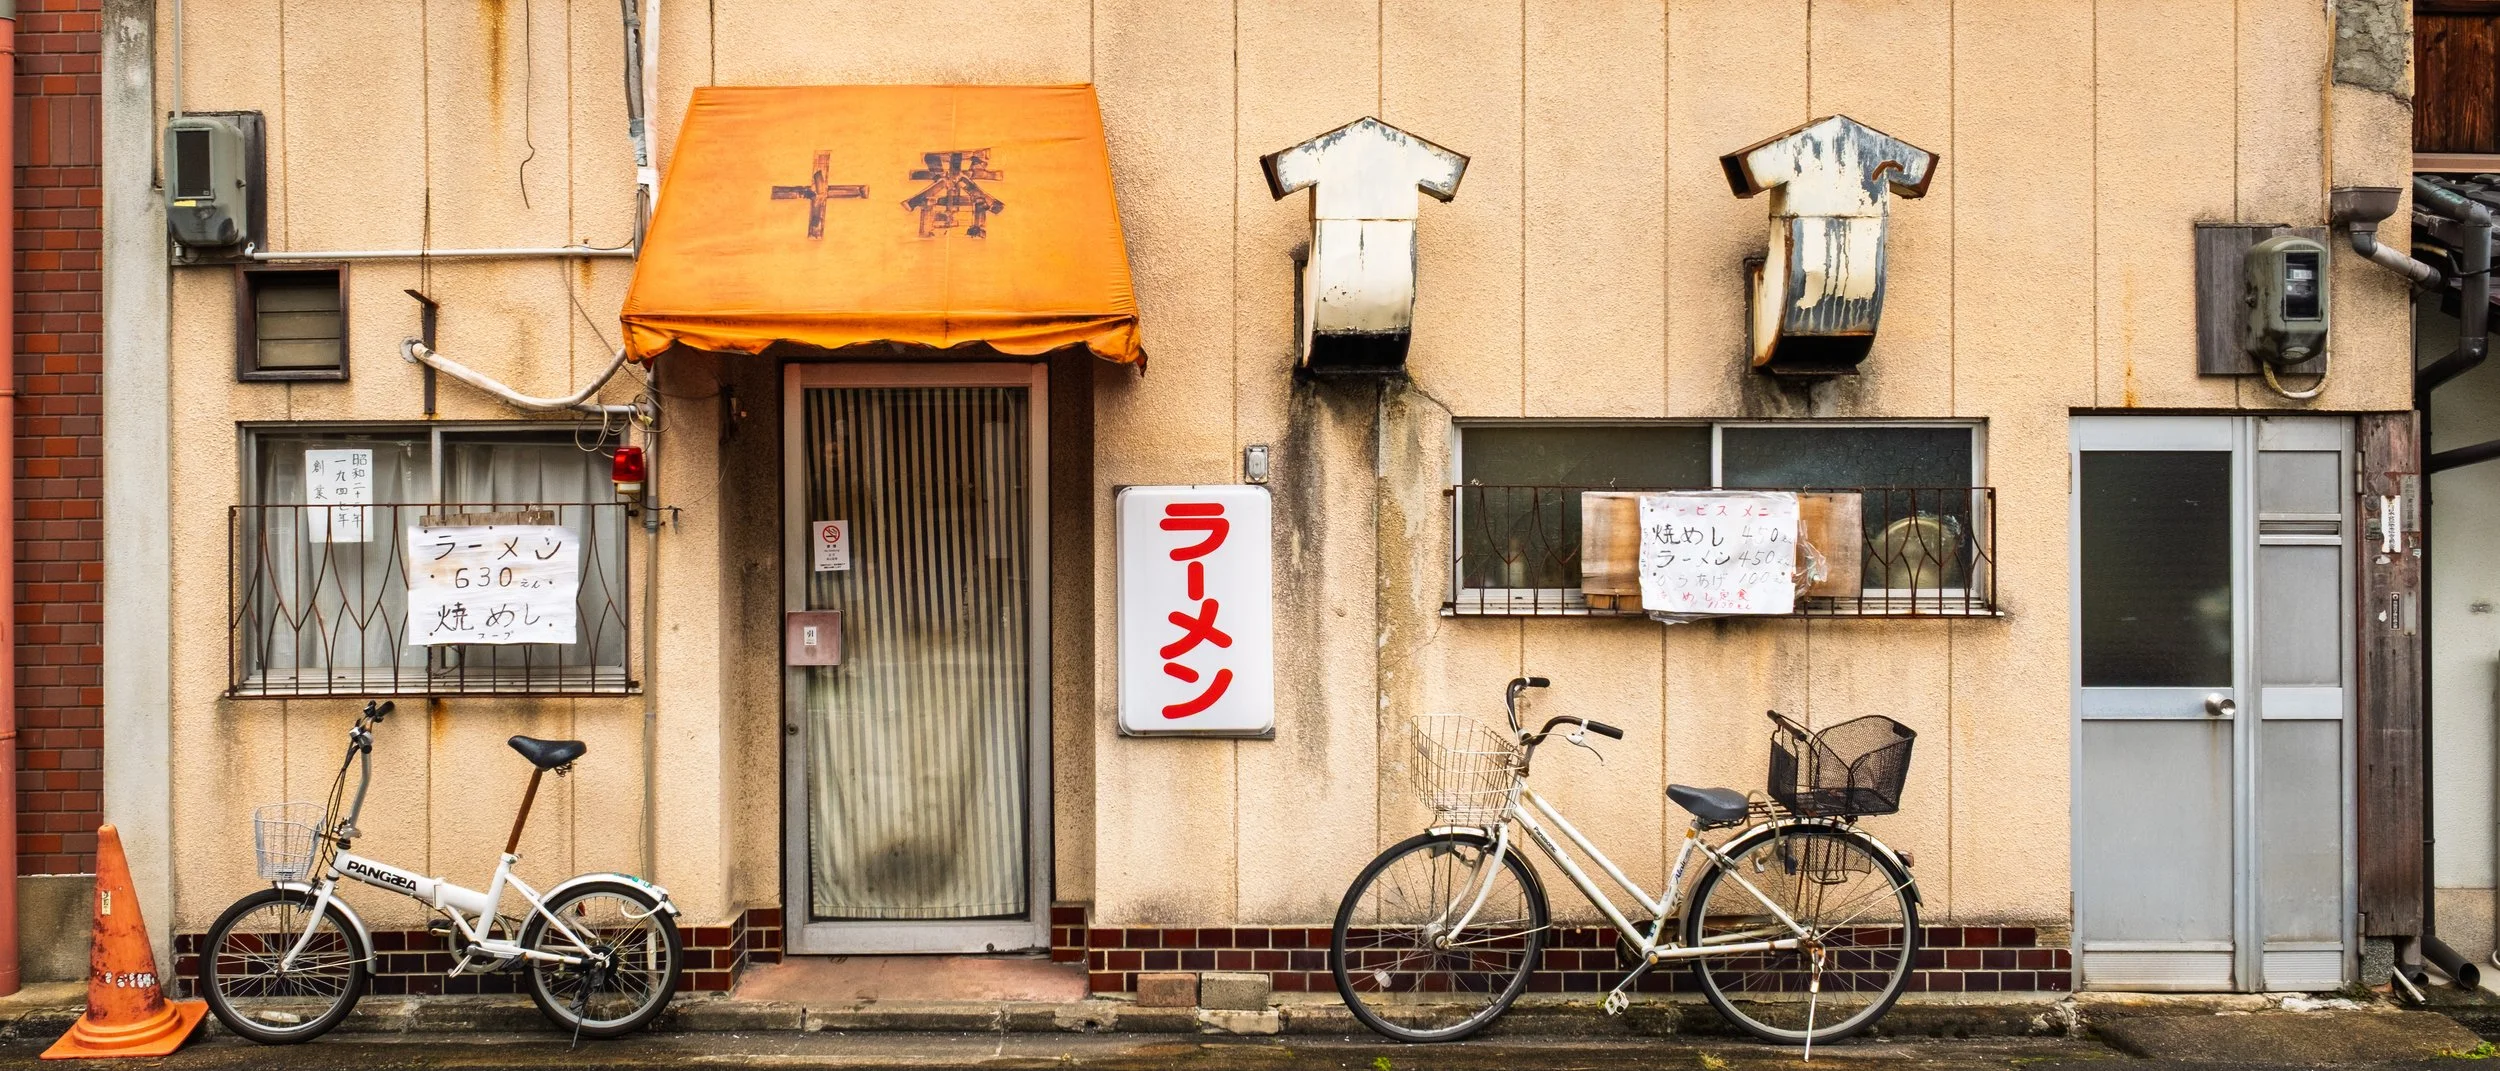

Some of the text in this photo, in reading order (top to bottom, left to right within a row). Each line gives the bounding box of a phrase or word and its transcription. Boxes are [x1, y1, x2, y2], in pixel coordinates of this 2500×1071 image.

[770, 146, 1006, 240] 十番
[334, 459, 350, 529] 一九四七年
[434, 534, 562, 561] ラーメン
[1652, 523, 1724, 547] 焼めし
[1656, 549, 1731, 568] ラーメン
[434, 601, 541, 632] 焼めし
[1159, 502, 1234, 720] ラーメン
